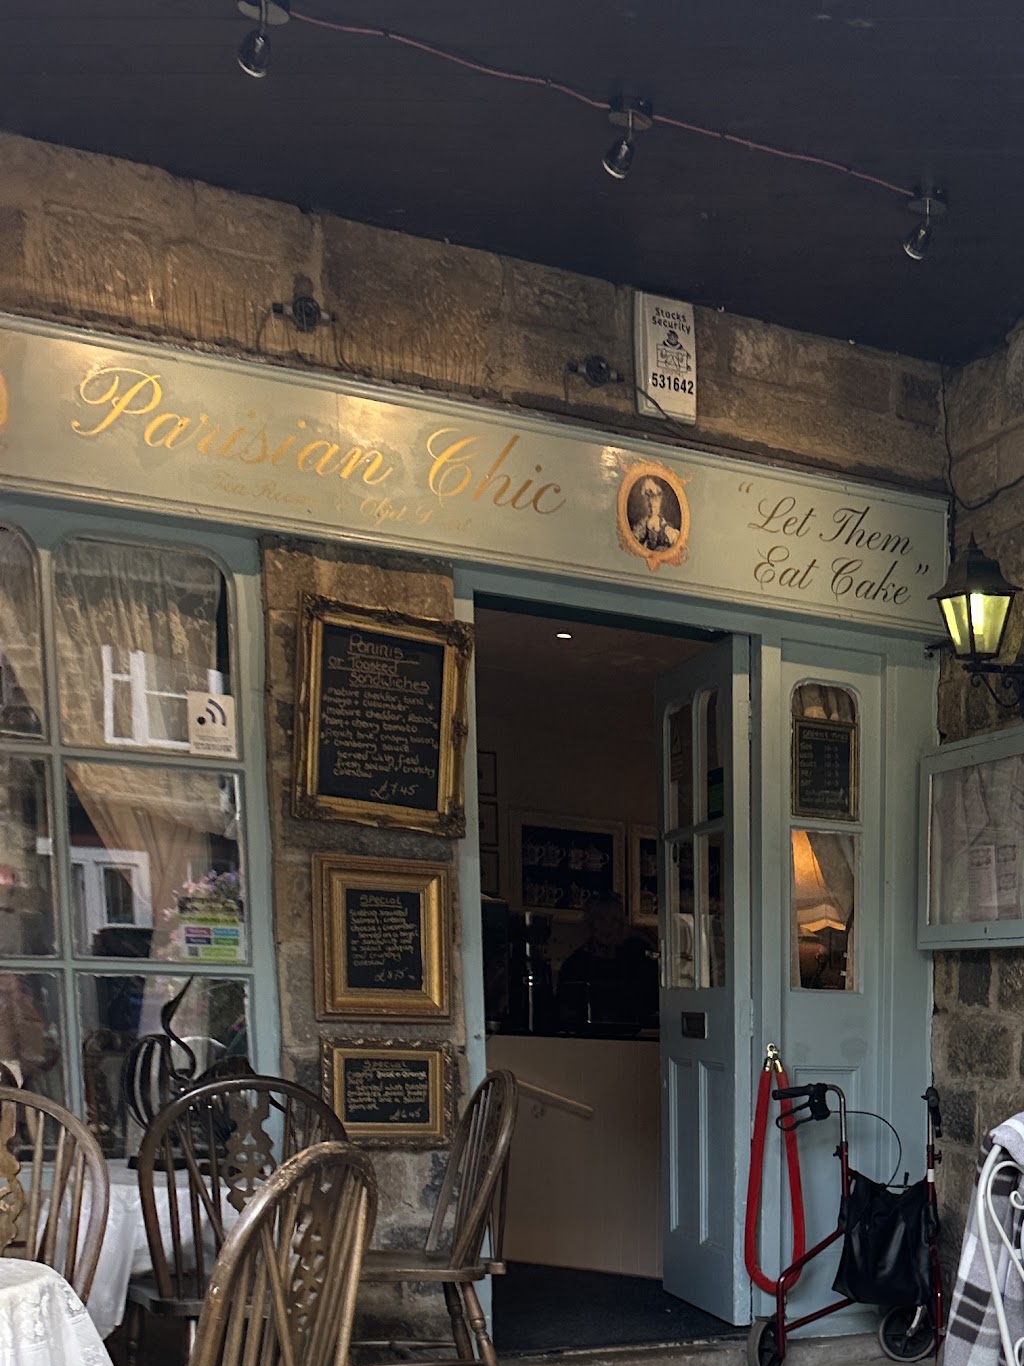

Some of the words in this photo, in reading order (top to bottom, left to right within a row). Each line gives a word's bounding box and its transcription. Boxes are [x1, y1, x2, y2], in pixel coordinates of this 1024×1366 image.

[651, 315, 691, 335] Security
[655, 306, 687, 322] Stocks
[651, 372, 694, 395] 531642
[70, 366, 393, 485] Parisian
[426, 427, 567, 515] Chic
[818, 505, 913, 555] Them
[753, 544, 820, 591] Eat
[328, 655, 345, 668] or
[345, 656, 399, 676] Toasted
[348, 671, 430, 692] Sandwiches
